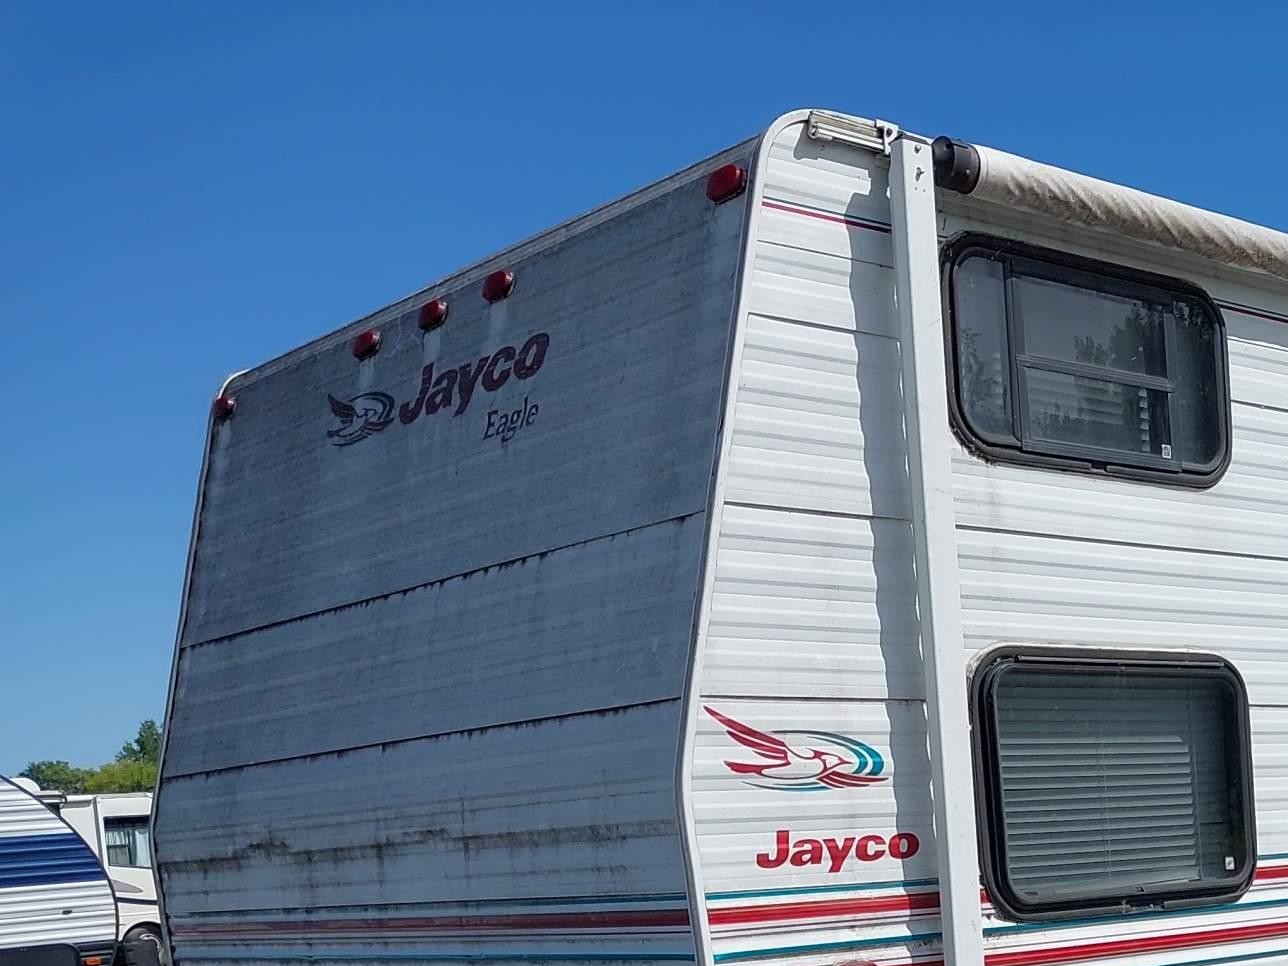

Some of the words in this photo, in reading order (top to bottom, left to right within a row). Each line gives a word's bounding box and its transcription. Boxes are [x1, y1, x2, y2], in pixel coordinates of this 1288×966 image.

[399, 332, 549, 424] Jayco
[482, 396, 539, 443] Eagle
[756, 829, 920, 873] Jayco
